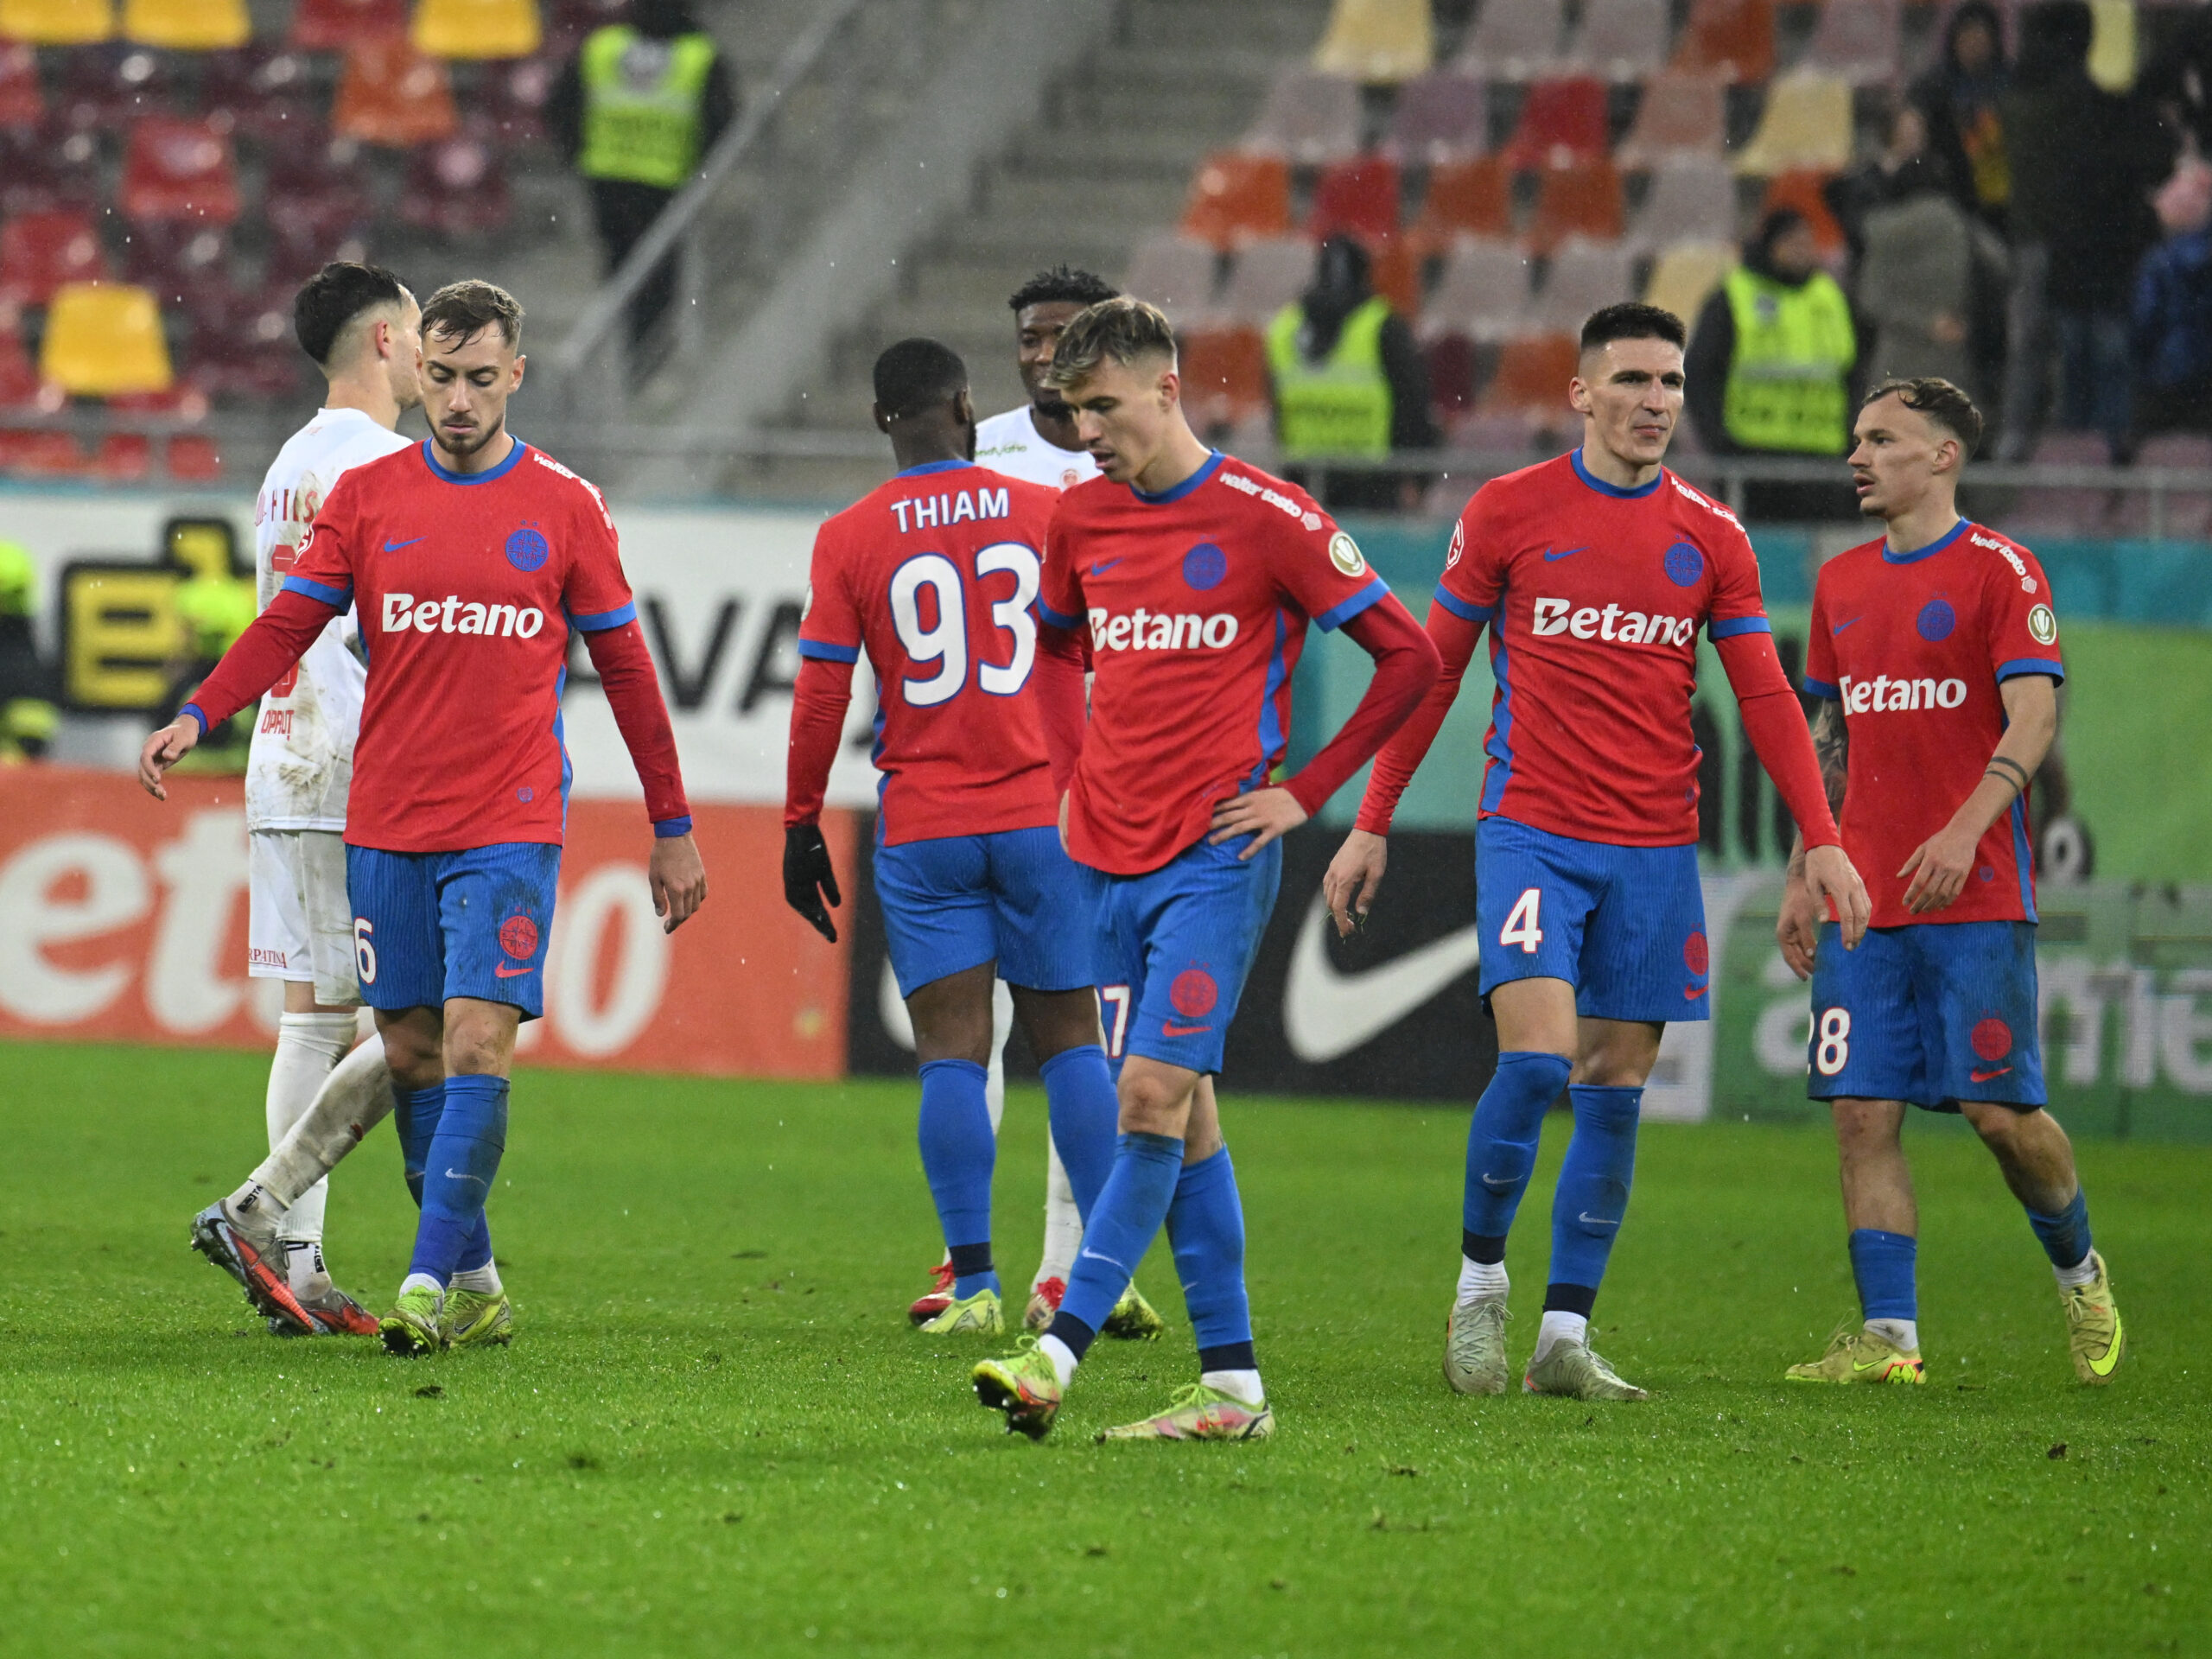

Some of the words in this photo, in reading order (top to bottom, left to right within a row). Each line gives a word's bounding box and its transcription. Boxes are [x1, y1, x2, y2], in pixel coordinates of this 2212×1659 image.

[890, 487, 1009, 533] THIAM
[382, 593, 543, 639] Betano
[887, 540, 1041, 709] 93
[1088, 607, 1238, 652] Betano
[1532, 597, 1693, 647] Betano
[1498, 887, 1543, 954] 4
[353, 916, 377, 985] 6
[1808, 1006, 1851, 1077] 8
